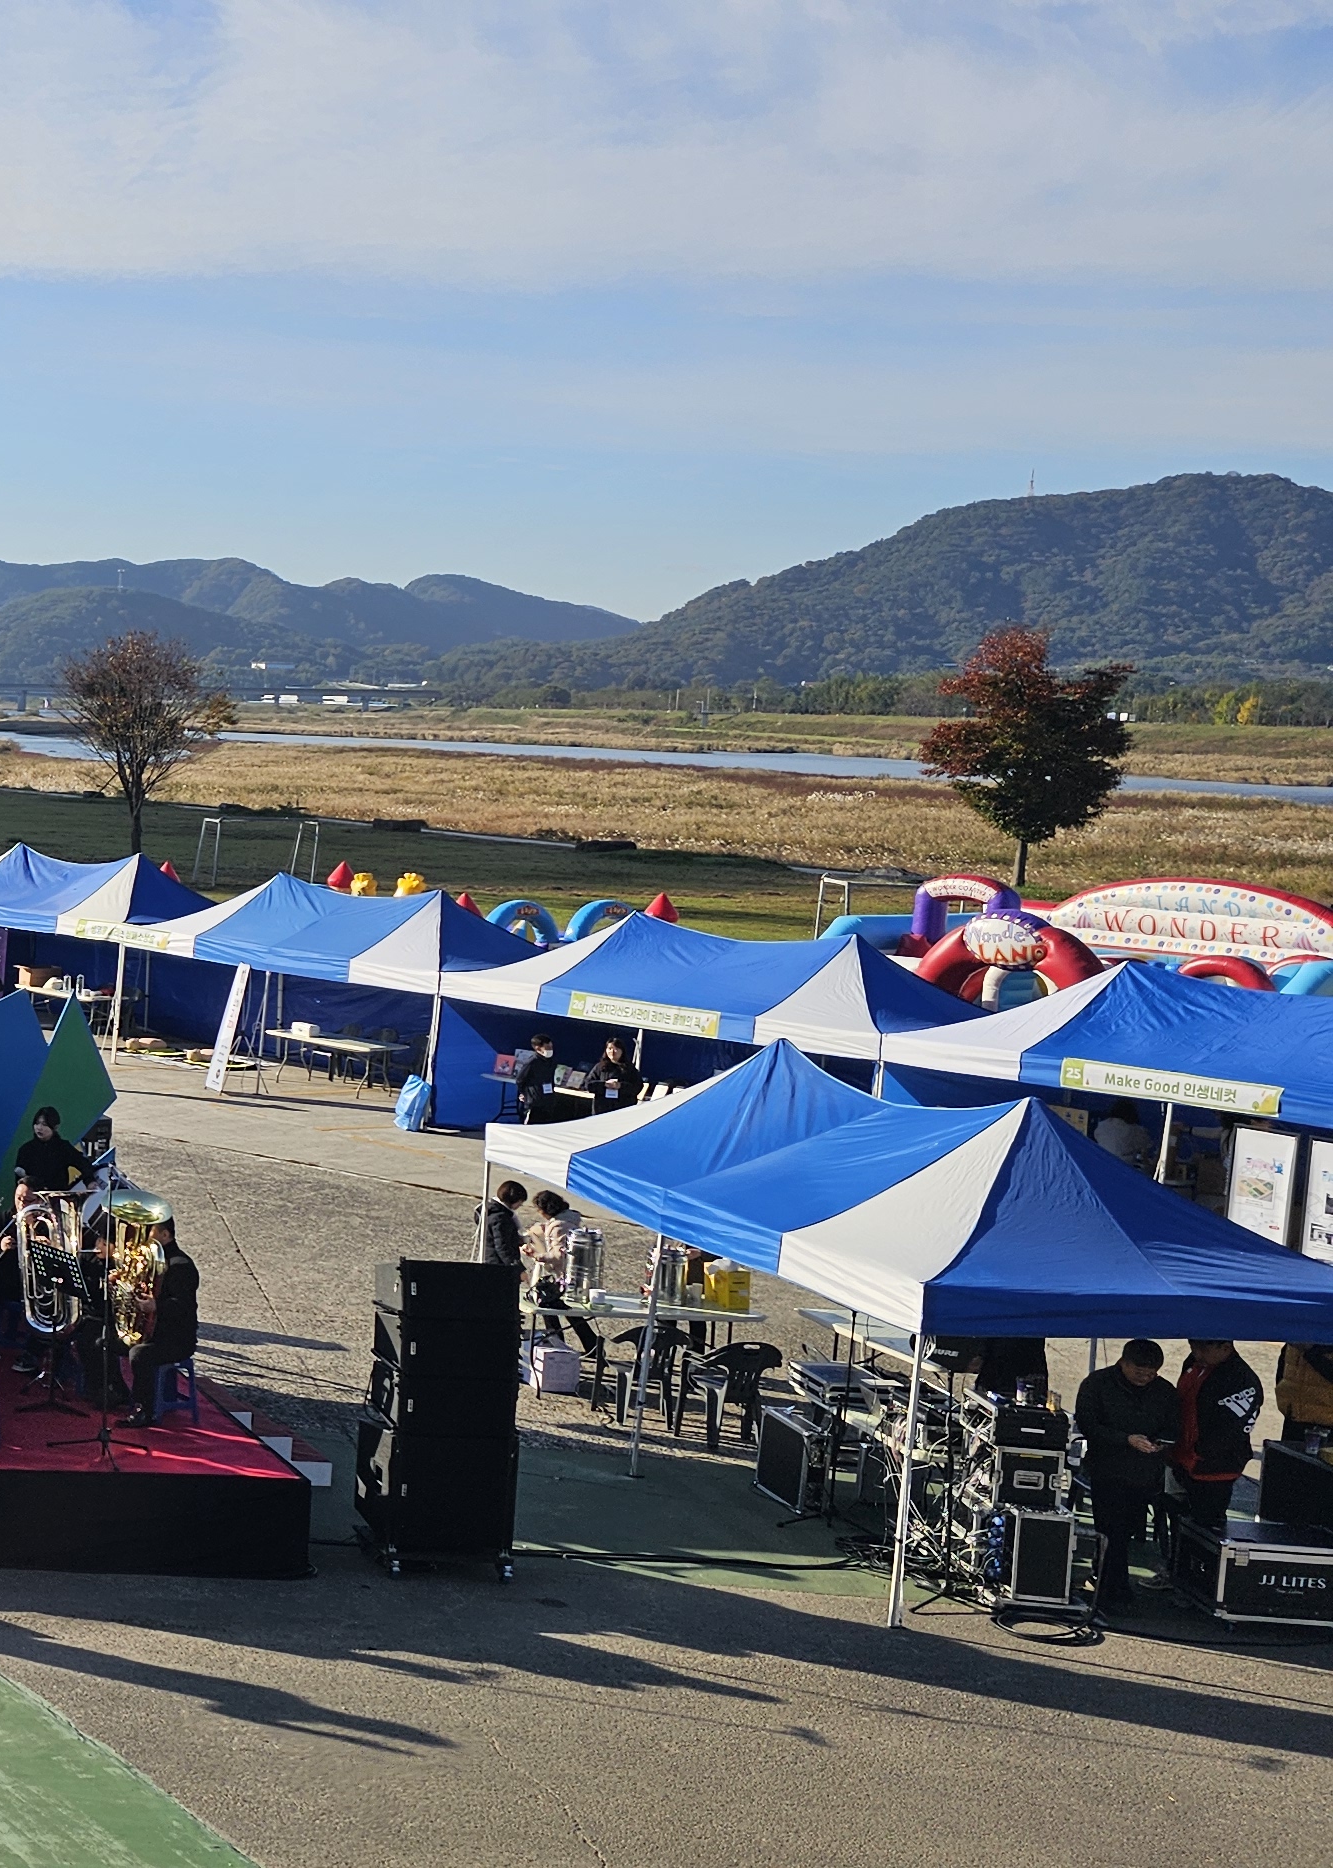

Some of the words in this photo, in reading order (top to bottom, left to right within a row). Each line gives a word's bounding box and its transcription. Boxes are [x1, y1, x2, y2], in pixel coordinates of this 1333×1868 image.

[1156, 895, 1241, 917] LAND
[1103, 909, 1282, 949] WONDER
[978, 943, 1048, 964] LAND
[1065, 1067, 1082, 1079] 25
[1104, 1072, 1141, 1089] Make
[1144, 1078, 1180, 1095] Good
[1184, 1082, 1237, 1104] 인생네컷
[1258, 1574, 1276, 1586] JJ
[1281, 1575, 1327, 1589] LITES
